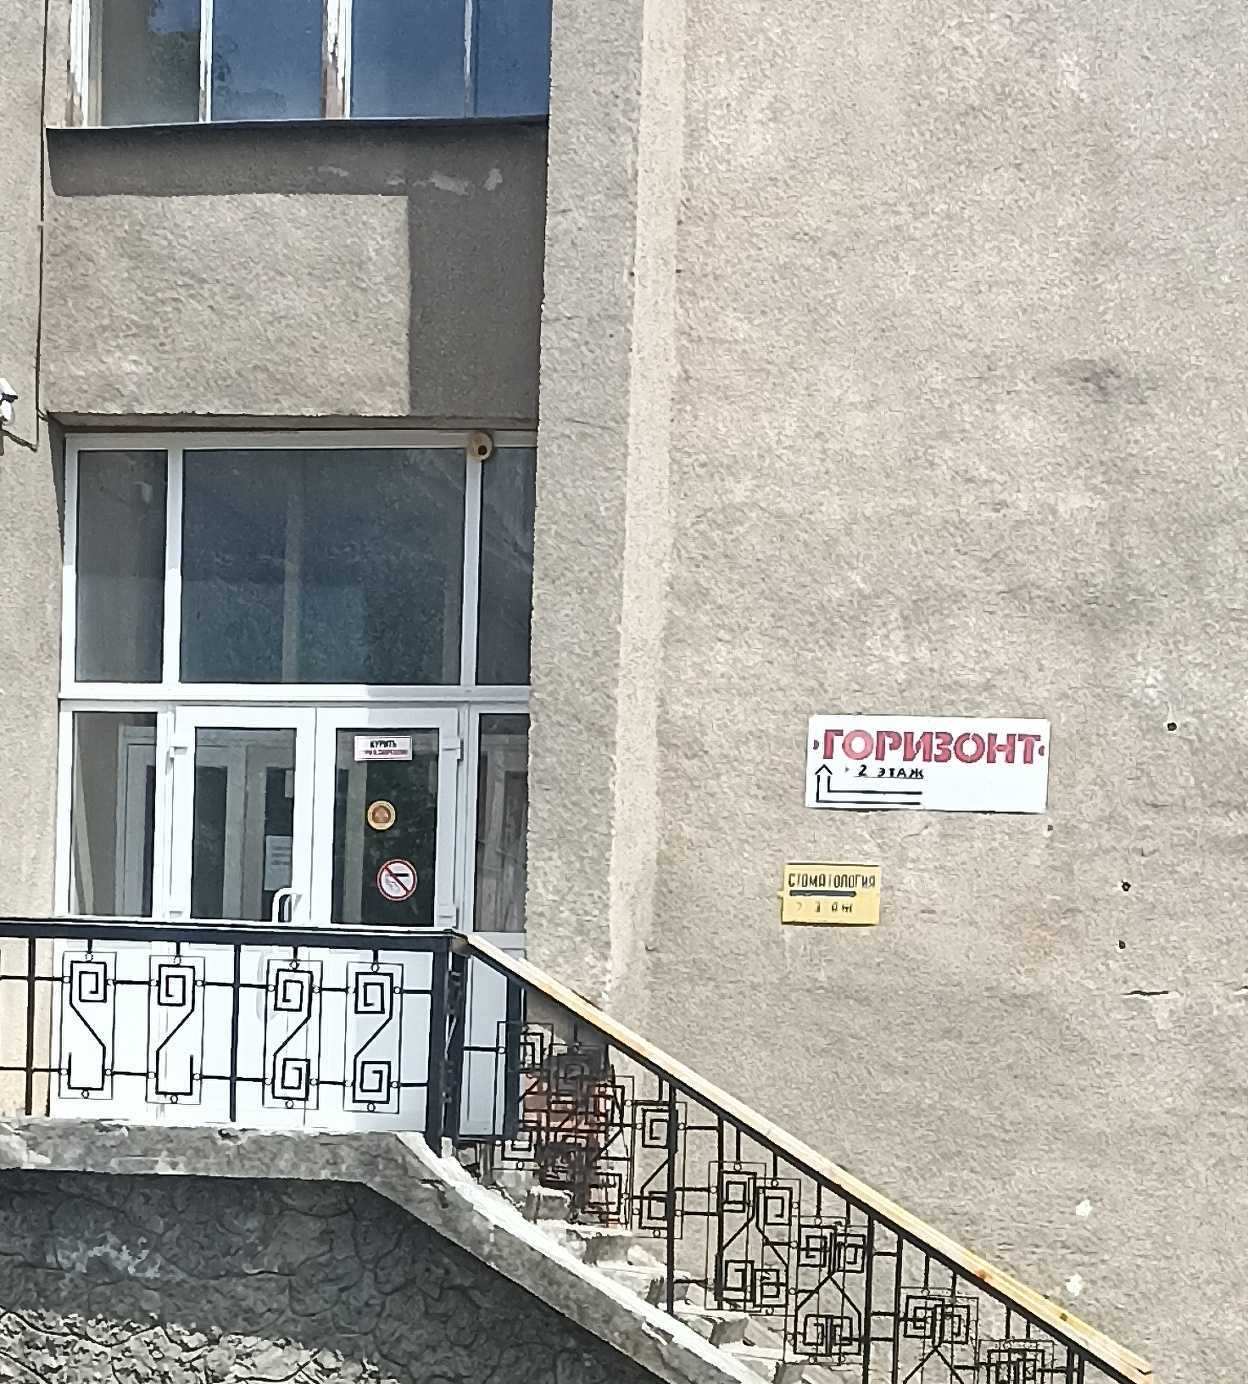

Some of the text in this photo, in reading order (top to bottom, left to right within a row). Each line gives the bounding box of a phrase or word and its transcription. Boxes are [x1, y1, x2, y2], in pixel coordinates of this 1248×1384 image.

[822, 729, 1041, 764] ГОРИЗОНТ
[858, 764, 924, 779] 2 ЭТАЖ
